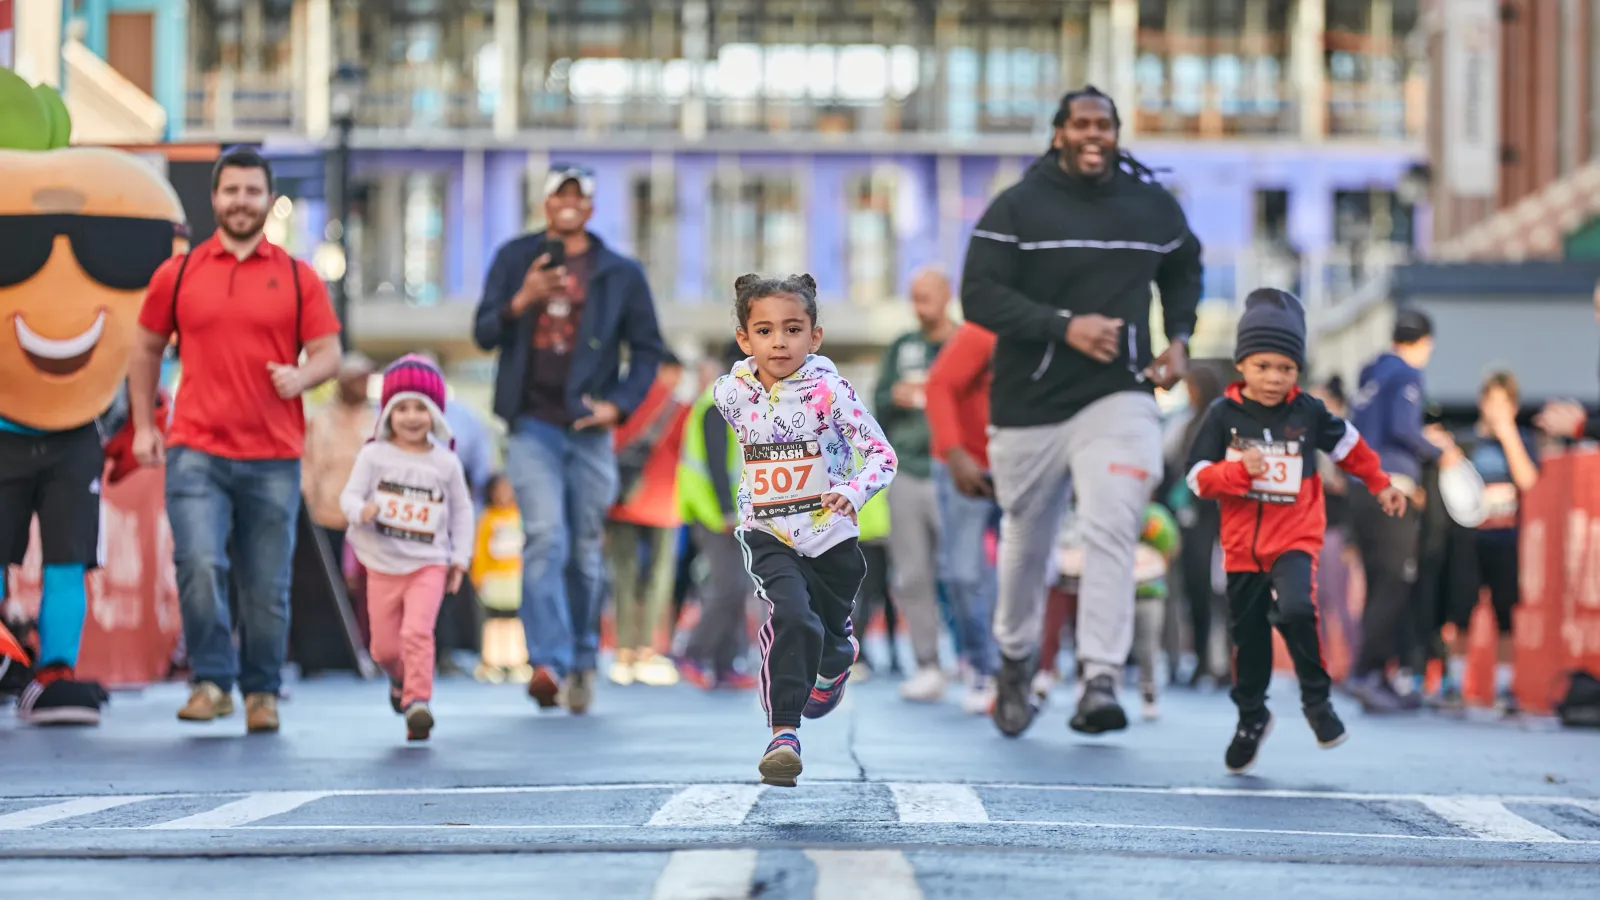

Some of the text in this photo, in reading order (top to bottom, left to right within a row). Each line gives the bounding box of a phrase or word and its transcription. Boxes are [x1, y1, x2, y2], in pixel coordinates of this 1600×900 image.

[770, 448, 804, 461] DASH
[775, 443, 803, 451] ATLANTA
[753, 463, 814, 496] 507
[385, 499, 429, 523] 554
